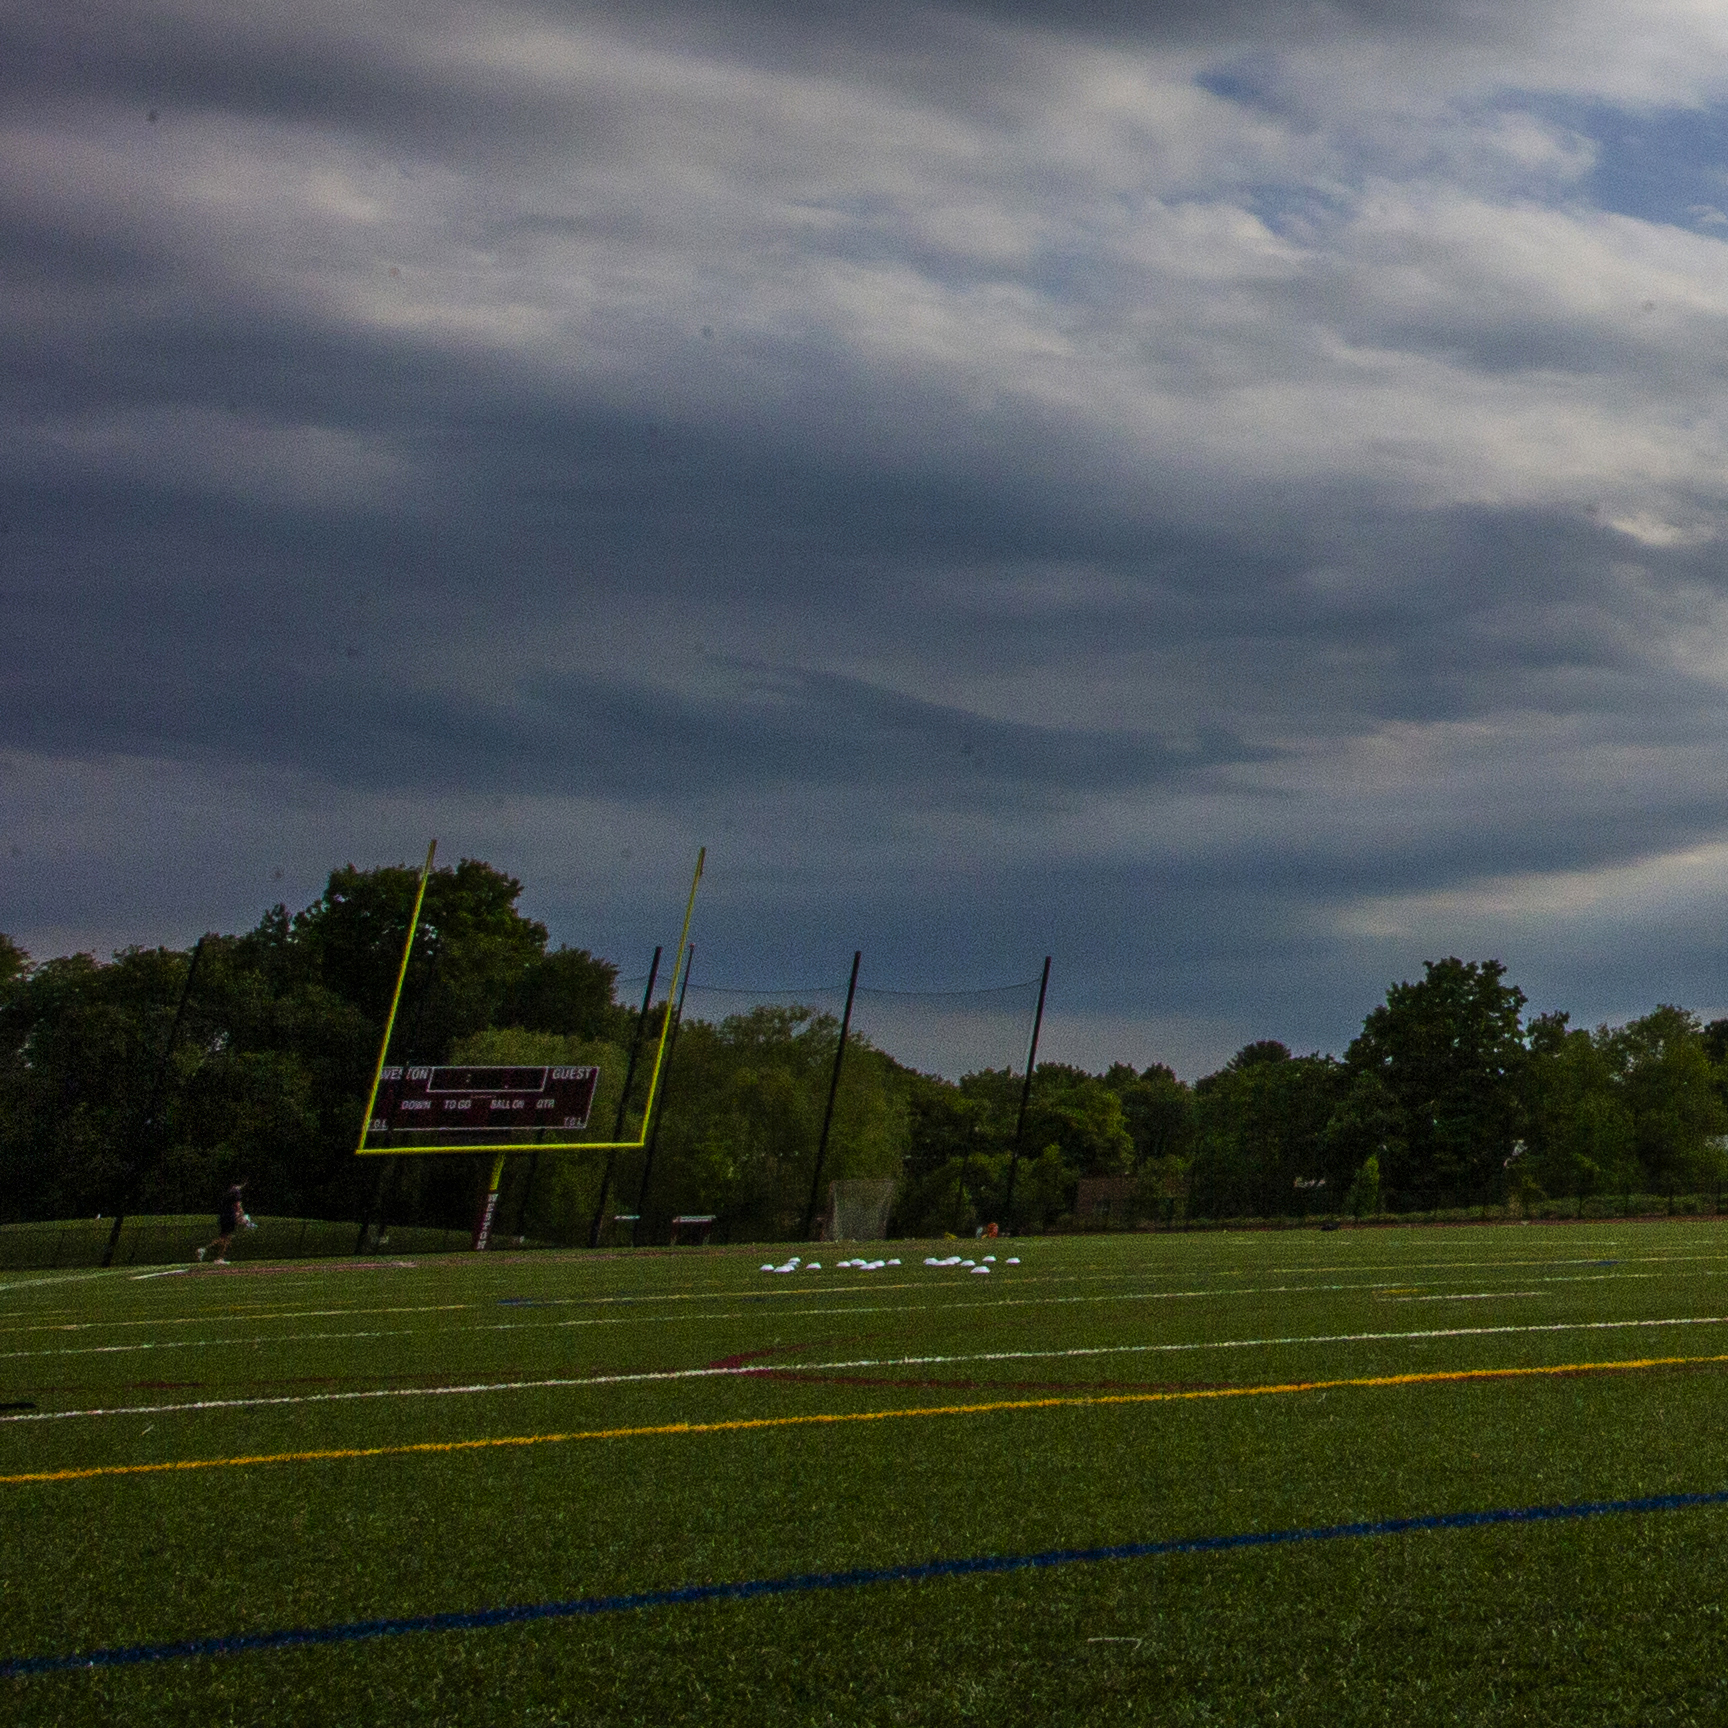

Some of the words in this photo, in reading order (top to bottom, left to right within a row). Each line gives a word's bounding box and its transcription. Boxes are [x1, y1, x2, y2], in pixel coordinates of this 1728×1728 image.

[552, 1067, 593, 1080] GUEST
[402, 1099, 432, 1110] DOWN
[444, 1099, 457, 1110] TO
[457, 1099, 472, 1110] GO
[490, 1099, 511, 1110] BALL
[512, 1099, 525, 1110] ON
